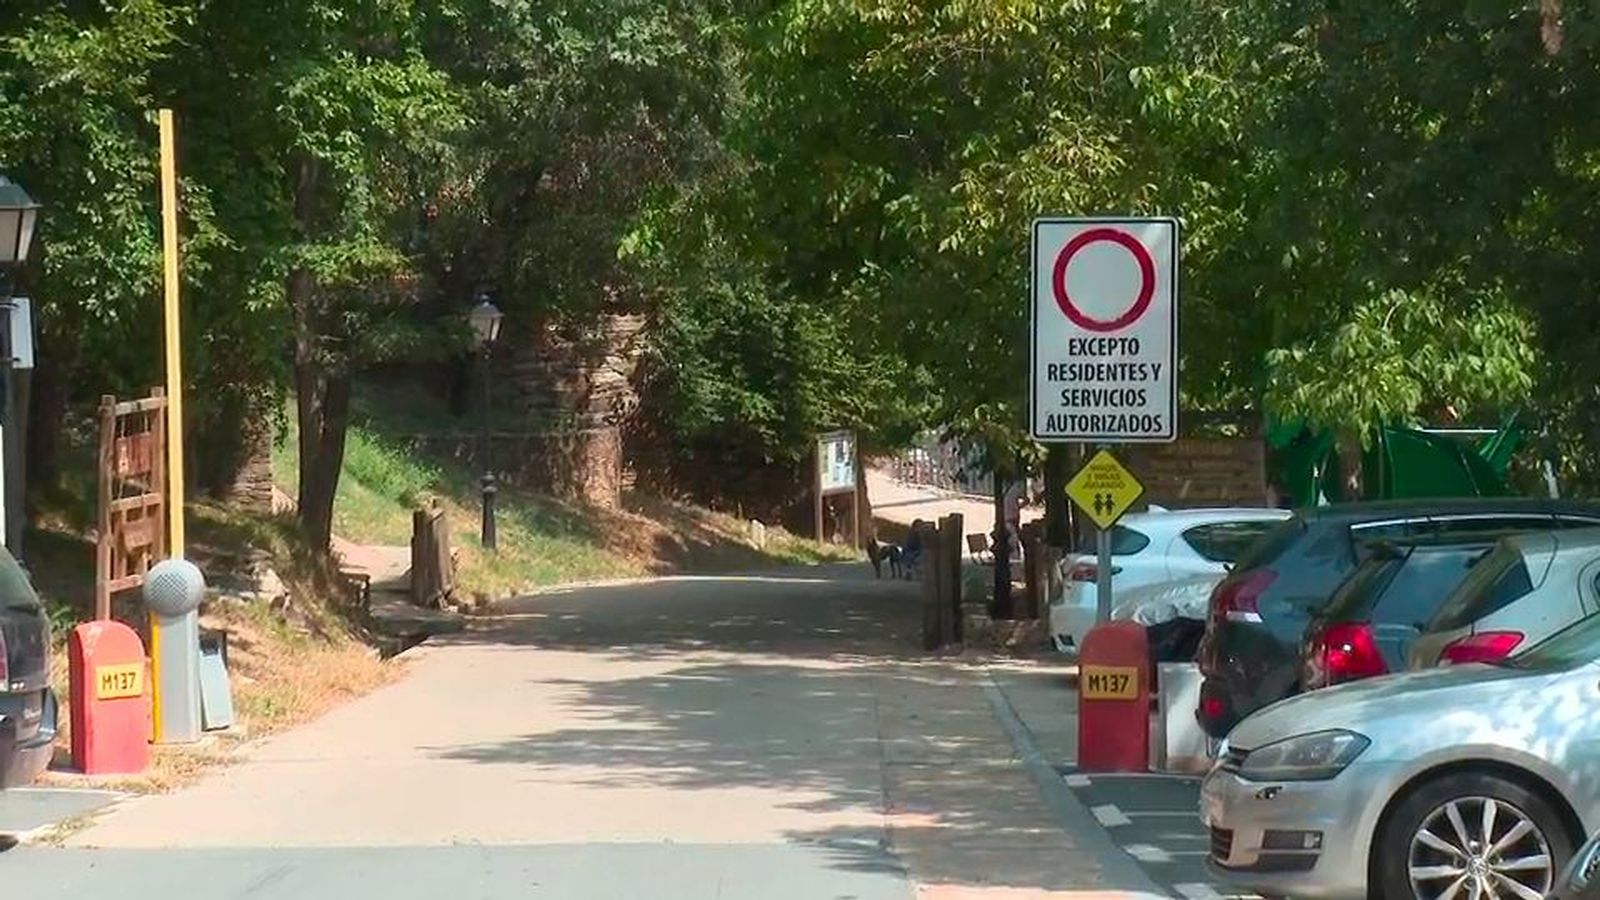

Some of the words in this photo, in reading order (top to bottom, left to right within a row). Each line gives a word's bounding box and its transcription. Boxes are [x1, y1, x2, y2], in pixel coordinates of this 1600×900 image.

[1069, 338, 1140, 356] EXCEPTO
[1048, 363, 1148, 382] RESIDENTES
[1151, 363, 1162, 381] Y
[1061, 388, 1147, 407] SERVICIOS
[1046, 414, 1162, 433] AUTORIZADOS
[102, 672, 136, 691] M137
[1088, 674, 1129, 693] M137
